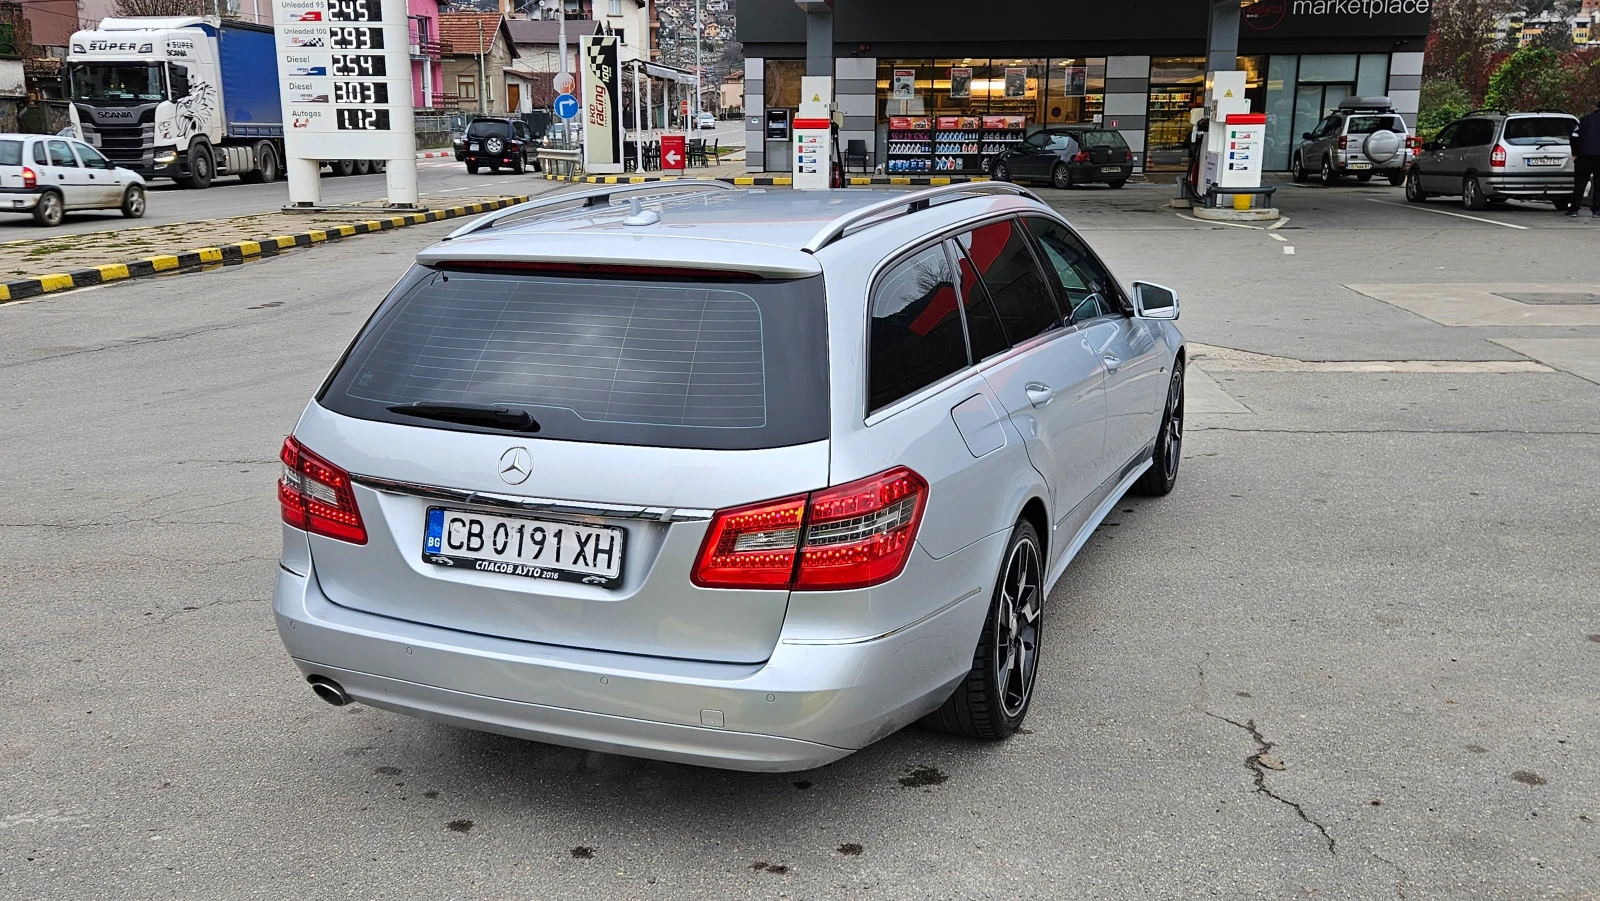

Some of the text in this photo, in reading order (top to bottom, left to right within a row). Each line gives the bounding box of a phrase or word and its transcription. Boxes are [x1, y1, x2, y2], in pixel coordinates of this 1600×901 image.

[281, 1, 314, 9] Unleaded
[328, 0, 369, 21] 2.45
[1293, 0, 1430, 18] marketplace
[89, 43, 137, 51] SUPER
[330, 27, 371, 49] 2.93
[286, 55, 310, 63] Diesel
[333, 55, 373, 76] 2.54
[601, 64, 610, 83] 100
[289, 82, 312, 90] Diesel
[335, 82, 376, 103] 3.03
[97, 111, 135, 119] SCANIA
[292, 110, 321, 118] Autogas
[595, 84, 606, 127] racing
[344, 109, 377, 130] 1.12
[427, 536, 441, 548] BG
[446, 517, 615, 569] CB 0191 XH
[475, 559, 559, 580] СПАСОВ АУТО 2016
